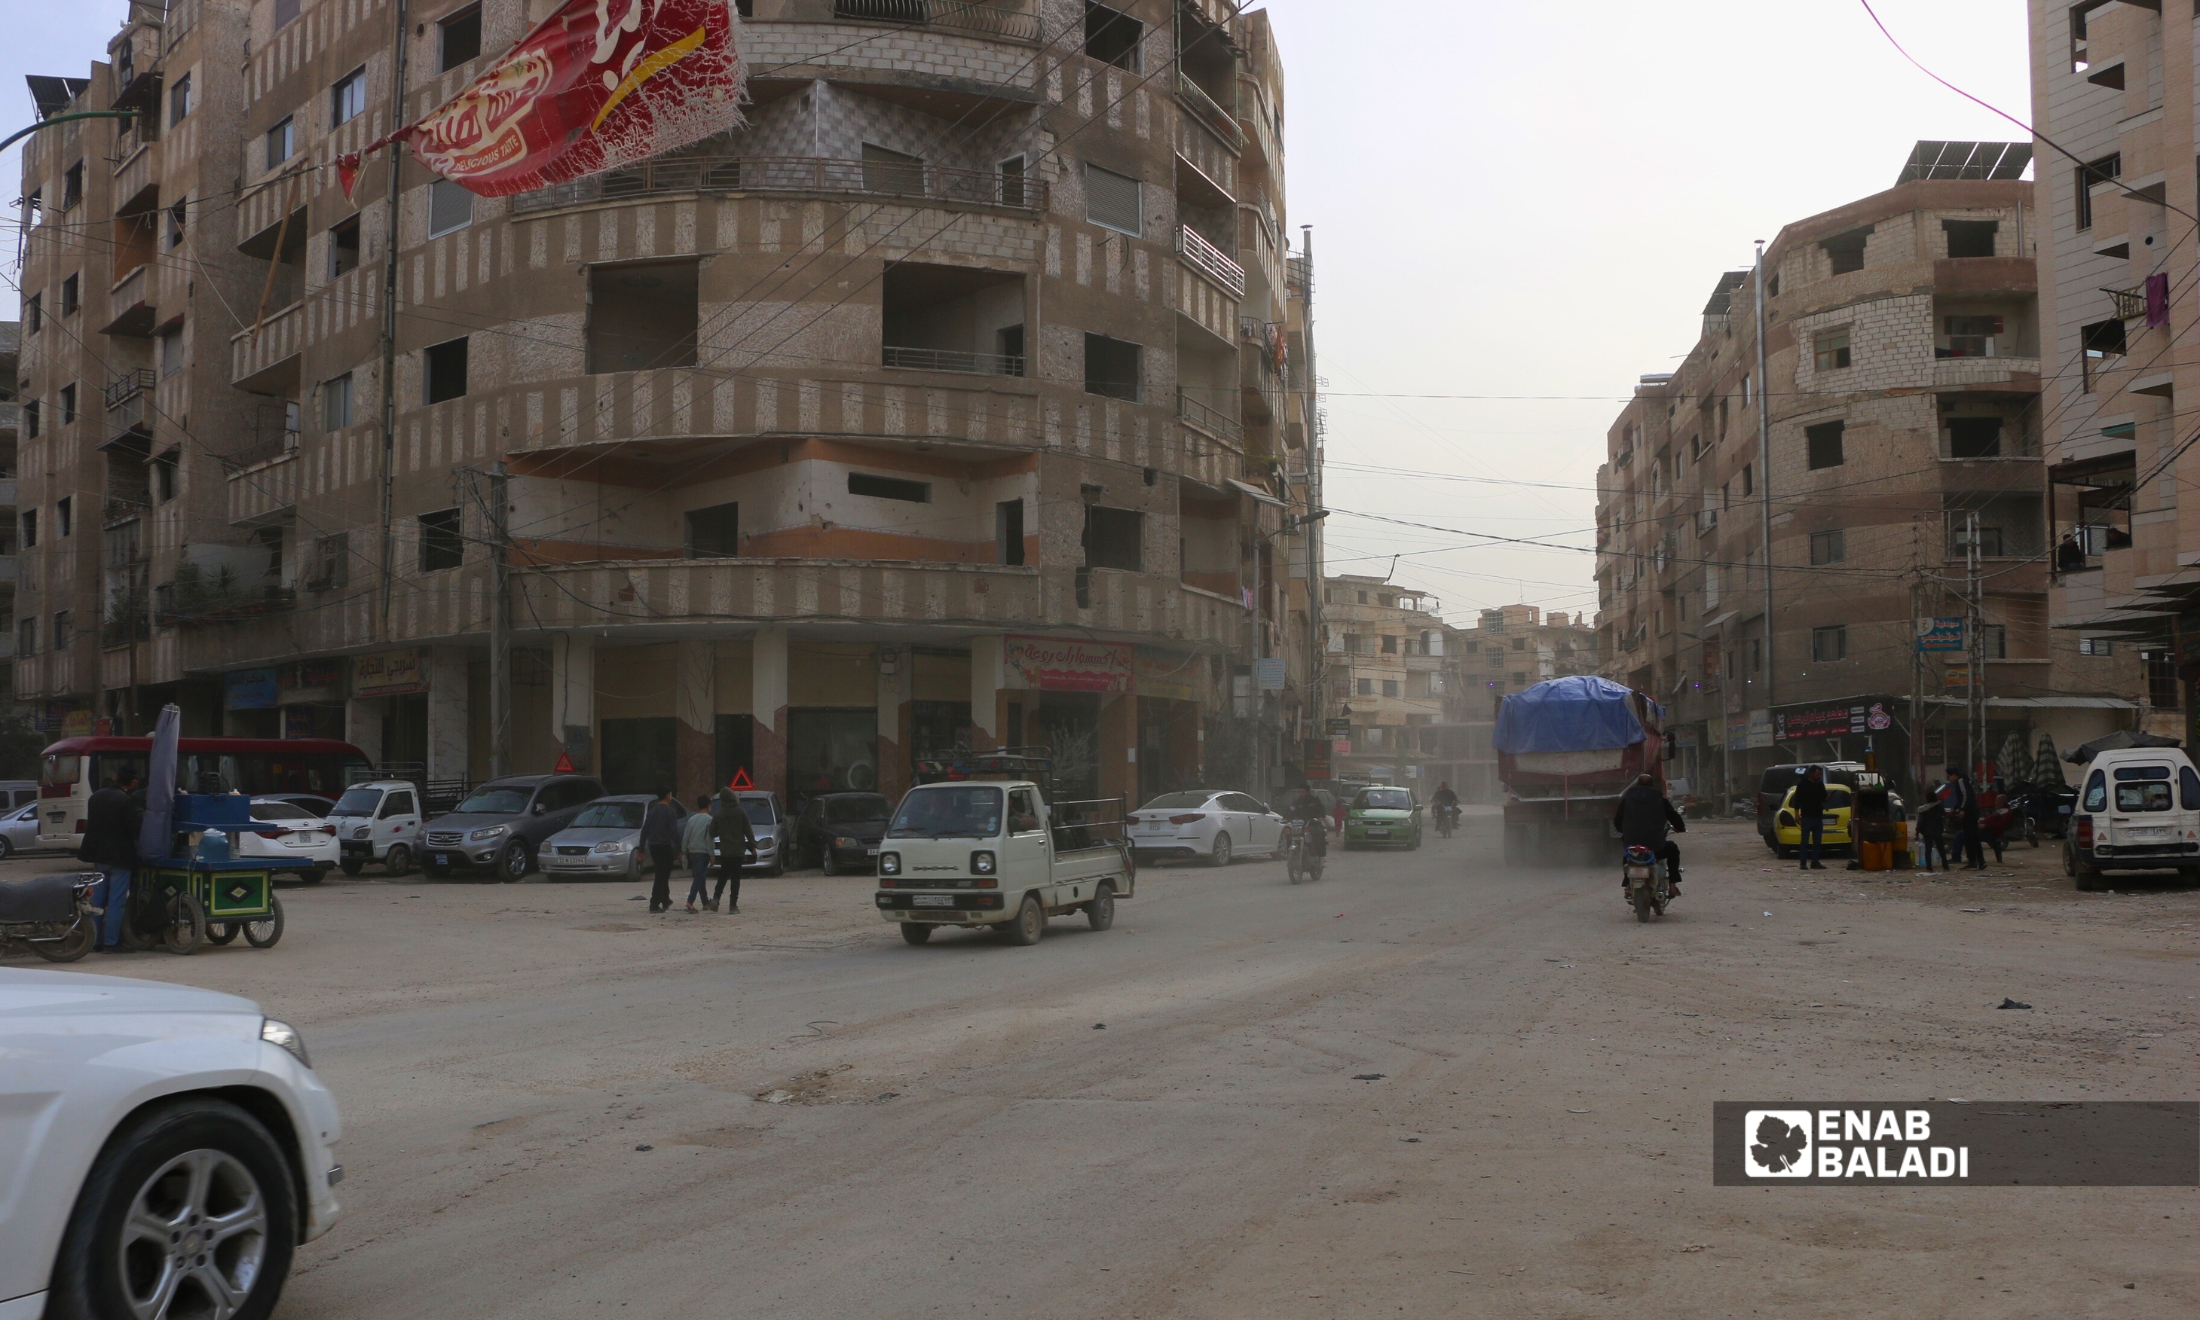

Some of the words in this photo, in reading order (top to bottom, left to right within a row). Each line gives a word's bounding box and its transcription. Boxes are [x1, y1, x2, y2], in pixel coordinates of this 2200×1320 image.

[453, 151, 499, 171] DELICIOUS
[500, 135, 519, 157] TASTE
[1826, 706, 1849, 723] مطعم
